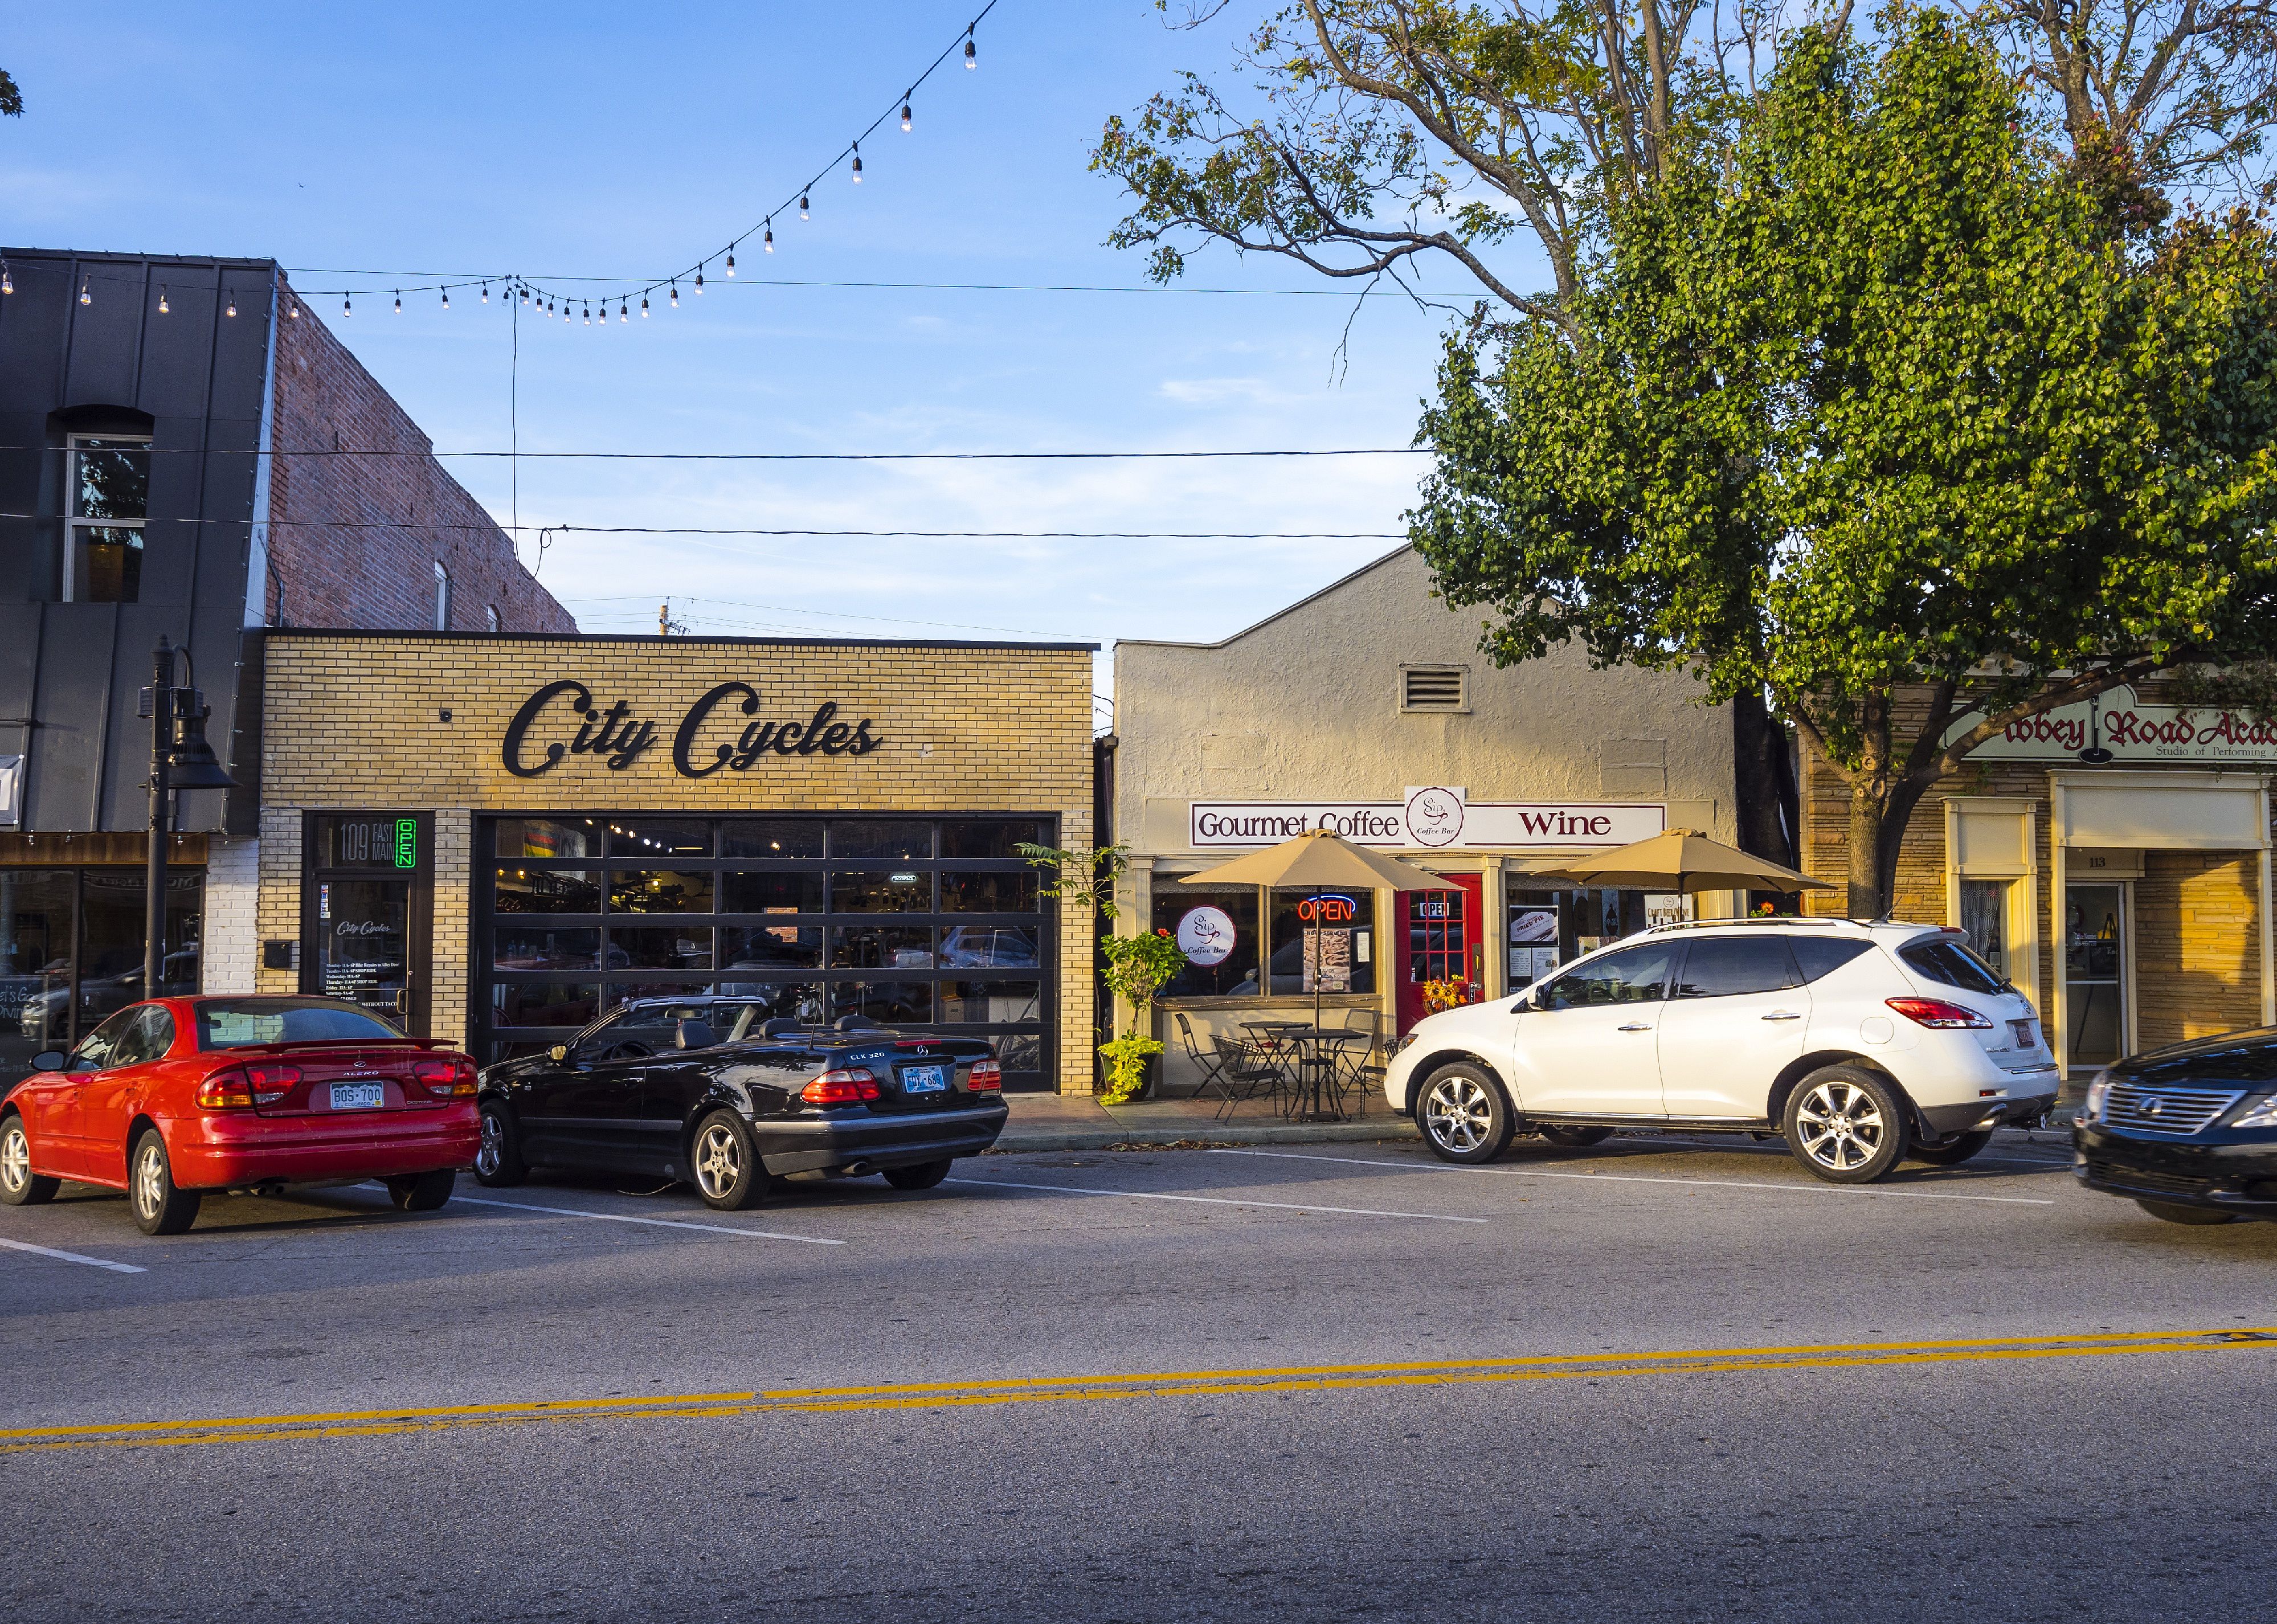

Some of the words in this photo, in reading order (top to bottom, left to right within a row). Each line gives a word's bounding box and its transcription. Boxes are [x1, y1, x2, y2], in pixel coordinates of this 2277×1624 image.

[502, 680, 659, 777] City
[672, 681, 883, 778] Cycles
[2104, 710, 2196, 747] Road
[2156, 746, 2189, 756] Studio
[2195, 746, 2206, 756] of
[2213, 746, 2266, 758] Performing
[1423, 797, 1444, 816] Sip
[373, 824, 394, 842] EAST
[1199, 812, 1309, 837] Gourmet
[1318, 811, 1400, 837] Coffee
[1518, 811, 1612, 836] Wine
[341, 824, 369, 860] 109
[372, 842, 395, 861] MAIN
[400, 822, 412, 865] OPEN
[2090, 857, 2106, 868] 113
[1298, 900, 1352, 921] OPEN
[337, 921, 359, 935] City
[360, 921, 391, 935] Cycles
[1194, 915, 1215, 935] Sip
[1187, 947, 1211, 955] Coffee
